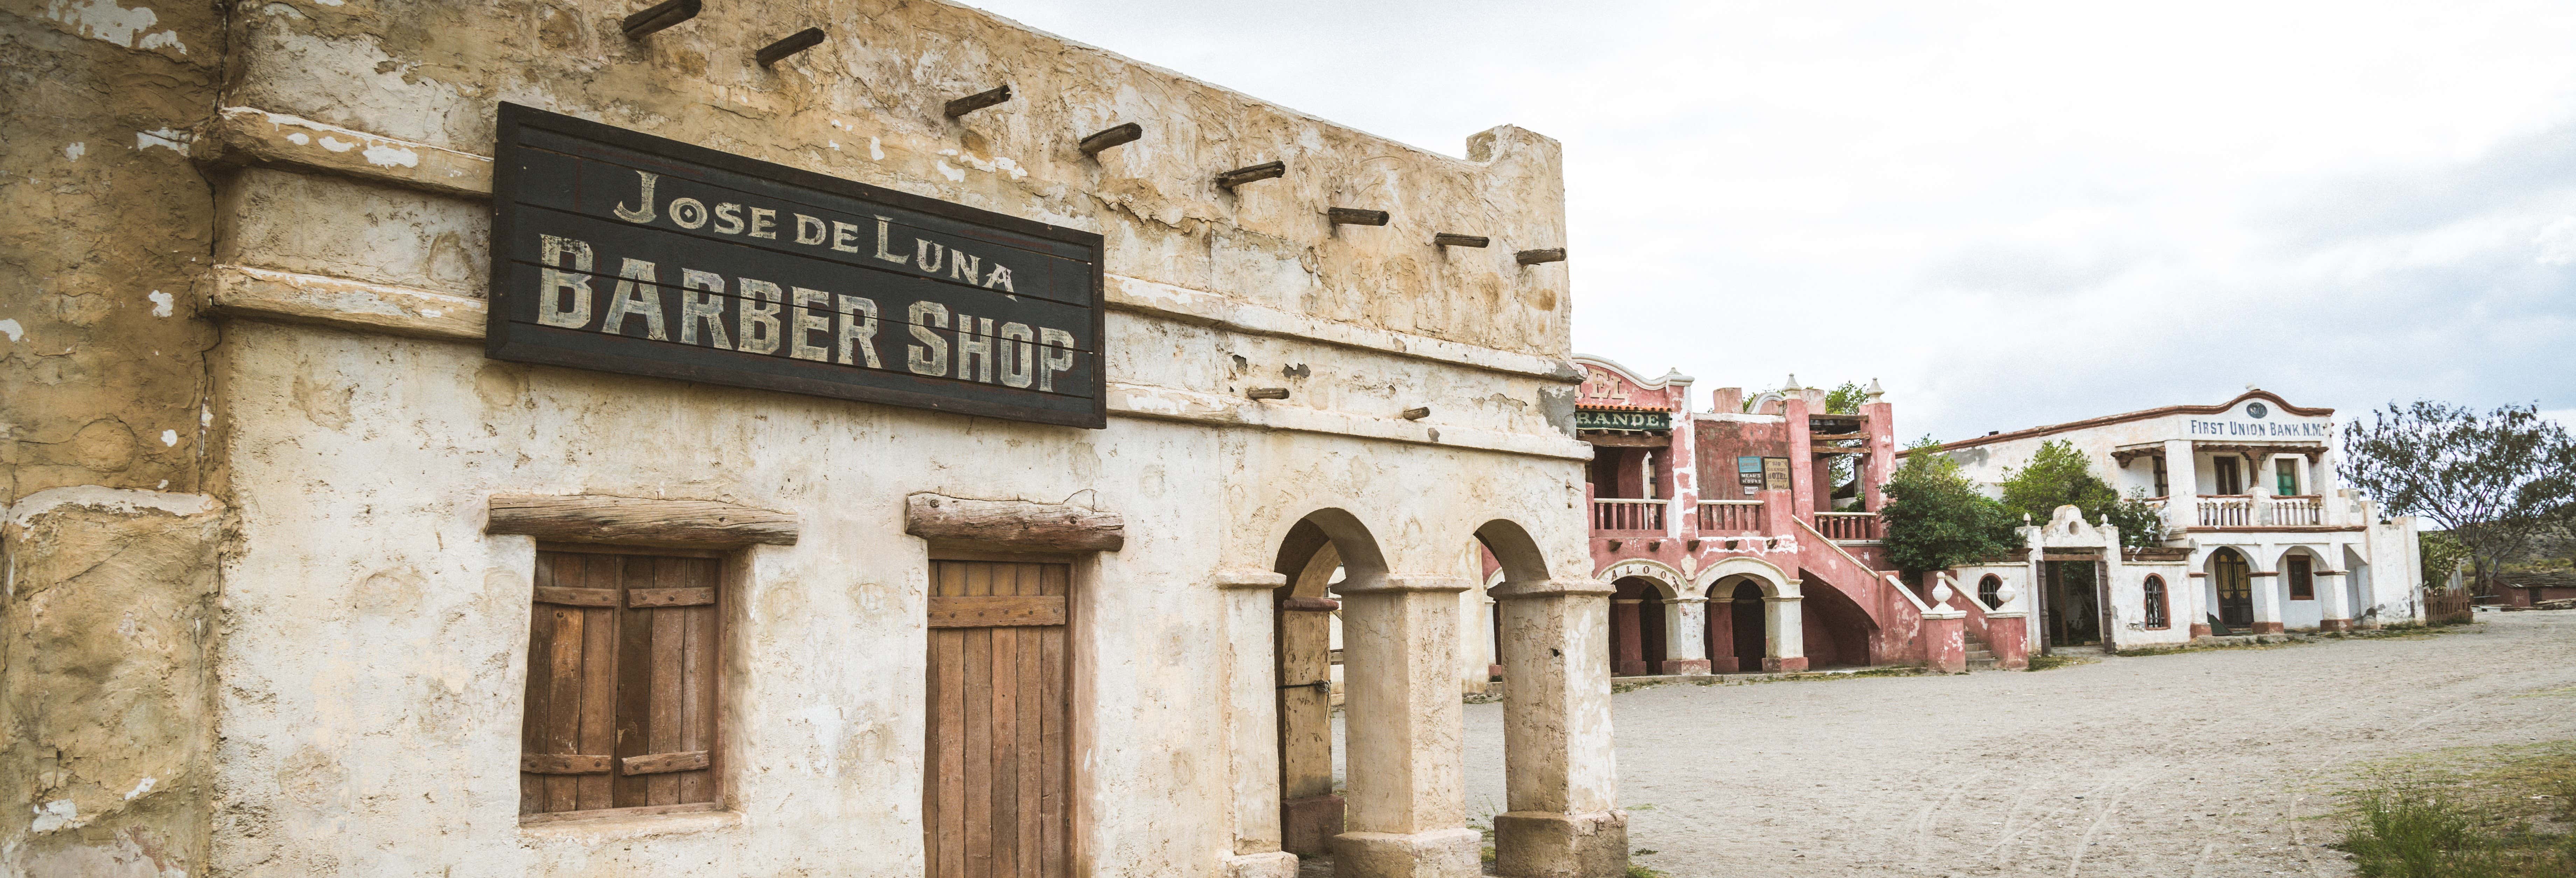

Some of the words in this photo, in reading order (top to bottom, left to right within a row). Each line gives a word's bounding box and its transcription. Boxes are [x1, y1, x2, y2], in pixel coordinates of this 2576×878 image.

[613, 170, 777, 240] JOSE
[793, 213, 858, 254] DE
[874, 214, 1018, 302] LUNA
[537, 233, 883, 370] BARBER
[908, 301, 1074, 393] SHOP
[2191, 420, 2224, 435] FIRST
[2230, 421, 2265, 436] UNION
[2270, 422, 2300, 436] BANK
[2303, 423, 2324, 436] N.M.
